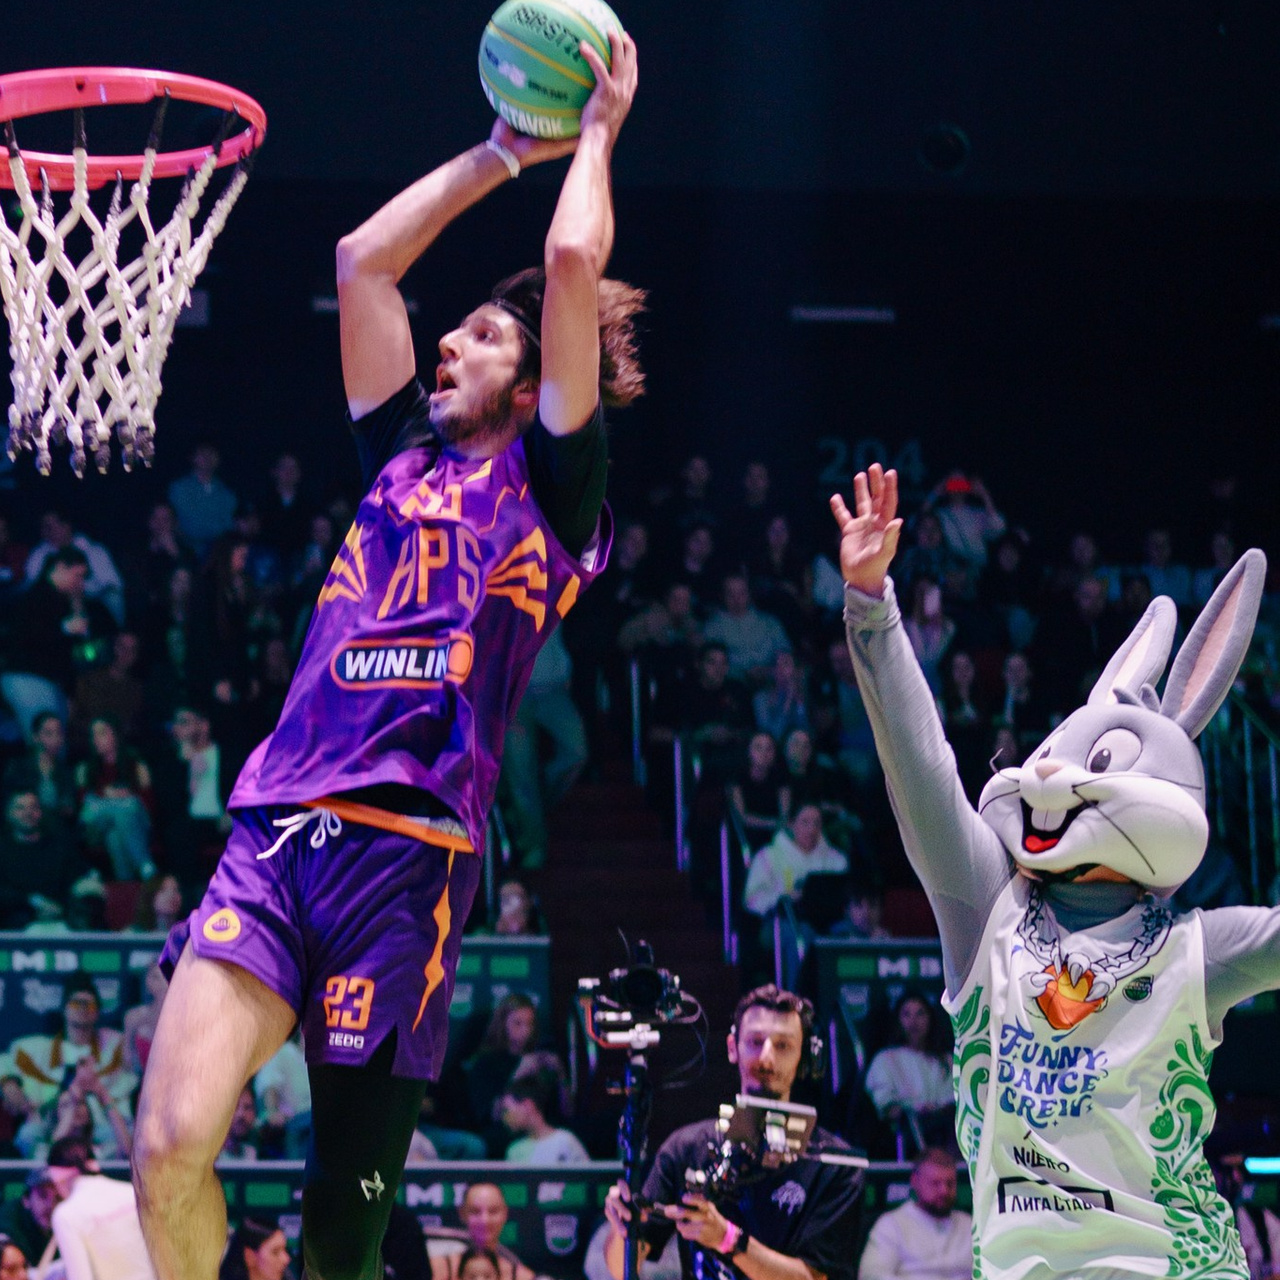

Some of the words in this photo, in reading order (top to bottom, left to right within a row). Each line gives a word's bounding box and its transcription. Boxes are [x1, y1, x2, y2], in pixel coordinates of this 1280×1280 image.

[323, 975, 375, 1031] 23
[998, 1018, 1107, 1070] FUNNY
[998, 1059, 1105, 1095] DANCE
[999, 1086, 1092, 1129] CREW
